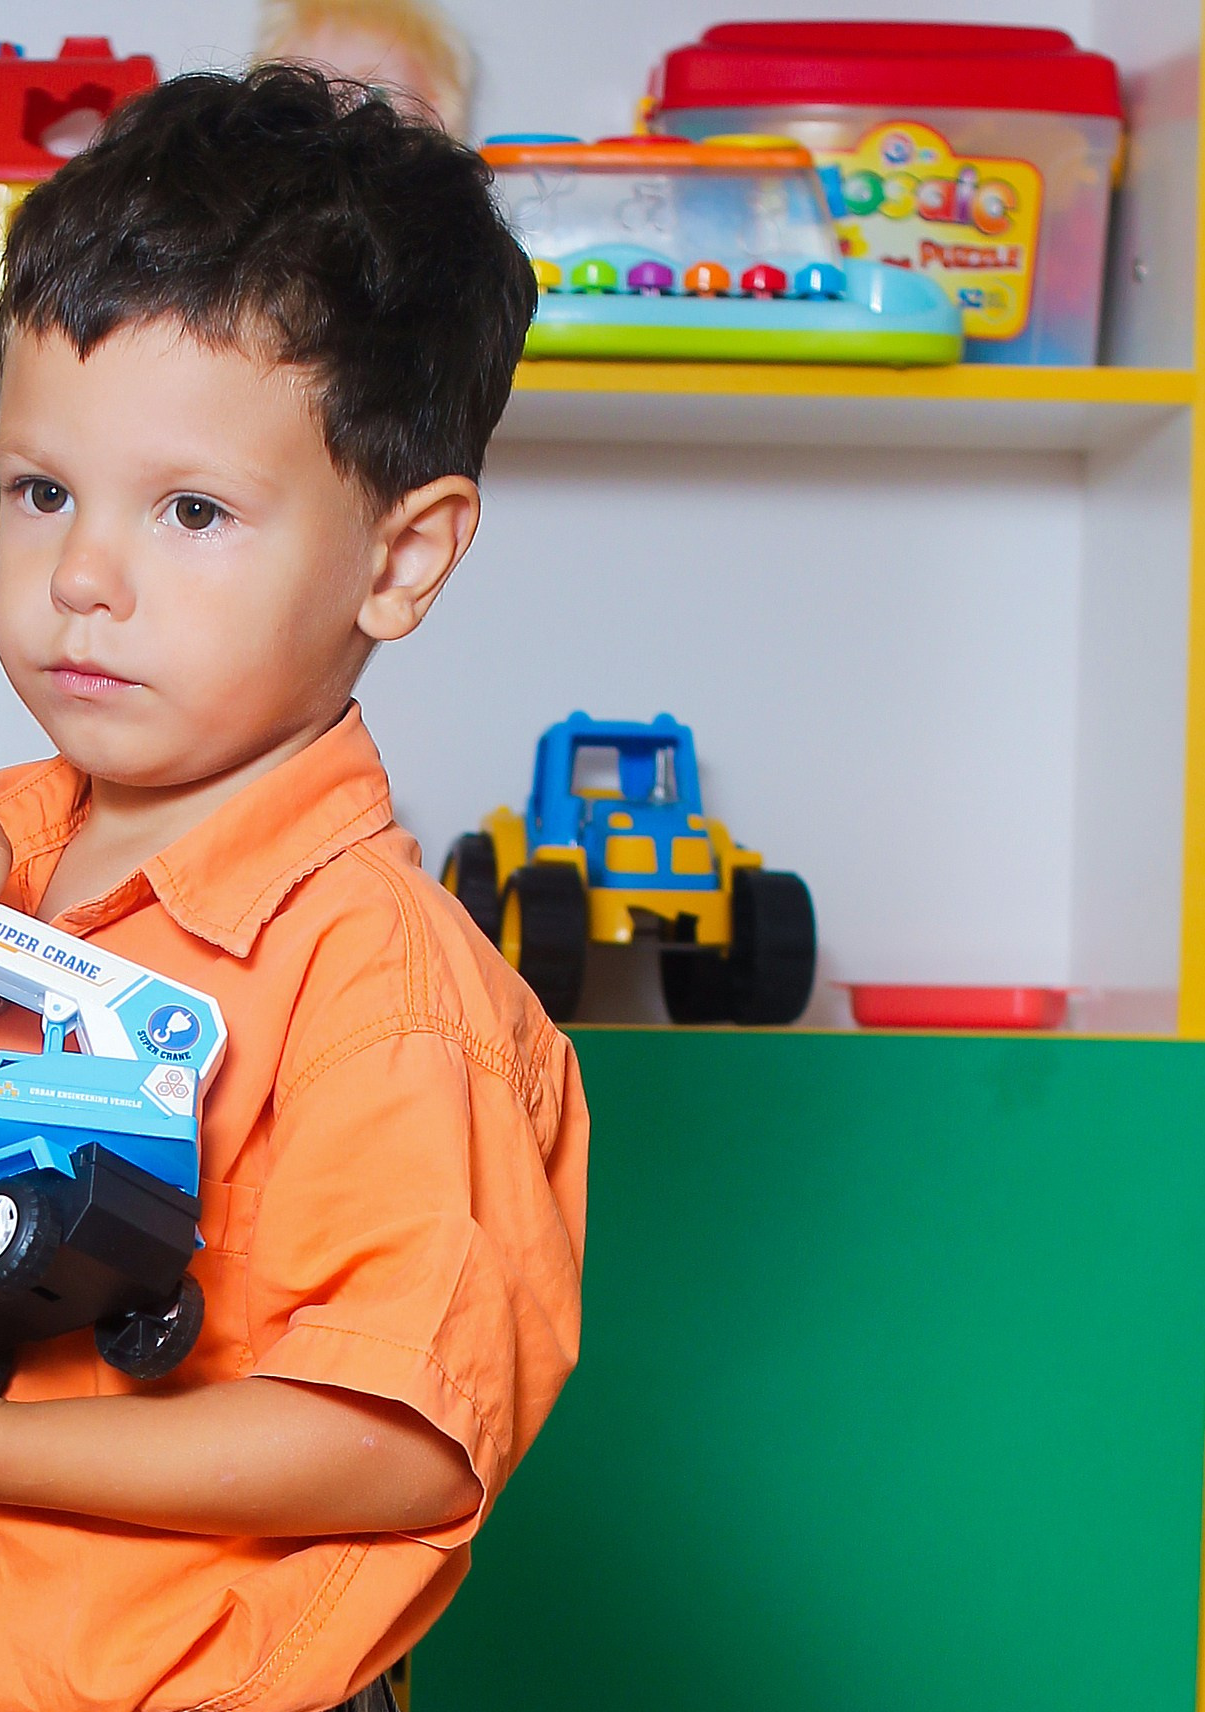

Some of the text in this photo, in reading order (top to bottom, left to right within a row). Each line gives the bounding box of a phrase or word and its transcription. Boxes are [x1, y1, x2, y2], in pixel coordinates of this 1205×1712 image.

[42, 945, 102, 980] CRANE
[137, 1030, 192, 1061] SUPER CRANE
[29, 1087, 143, 1109] URBAN ENGINEERING VEHICLE
